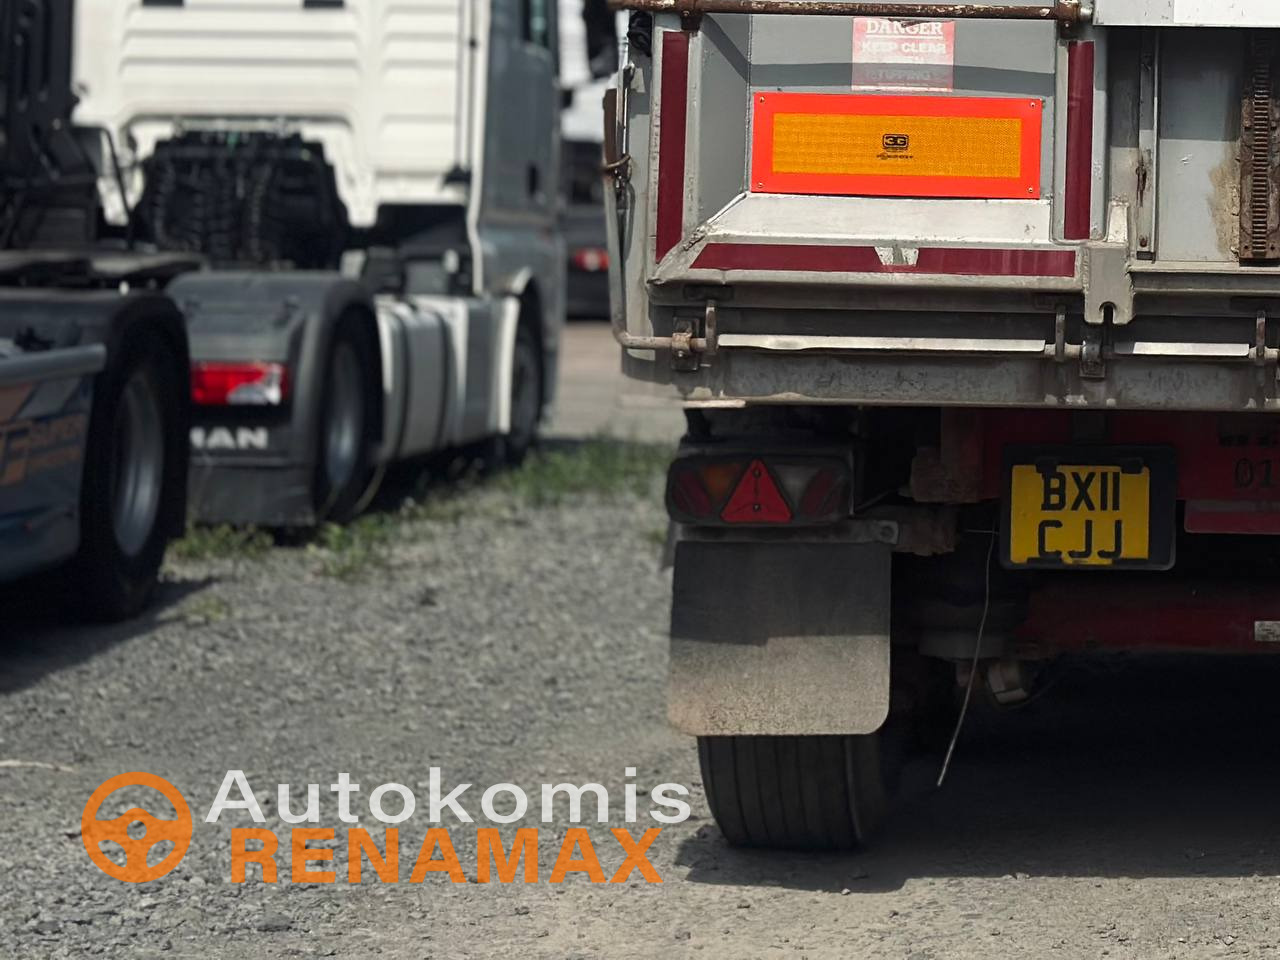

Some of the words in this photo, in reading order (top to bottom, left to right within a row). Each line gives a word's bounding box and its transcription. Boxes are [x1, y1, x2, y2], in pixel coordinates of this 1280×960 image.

[865, 19, 944, 35] DANGER
[1041, 471, 1121, 511] BX11
[1038, 519, 1123, 559] CJJ
